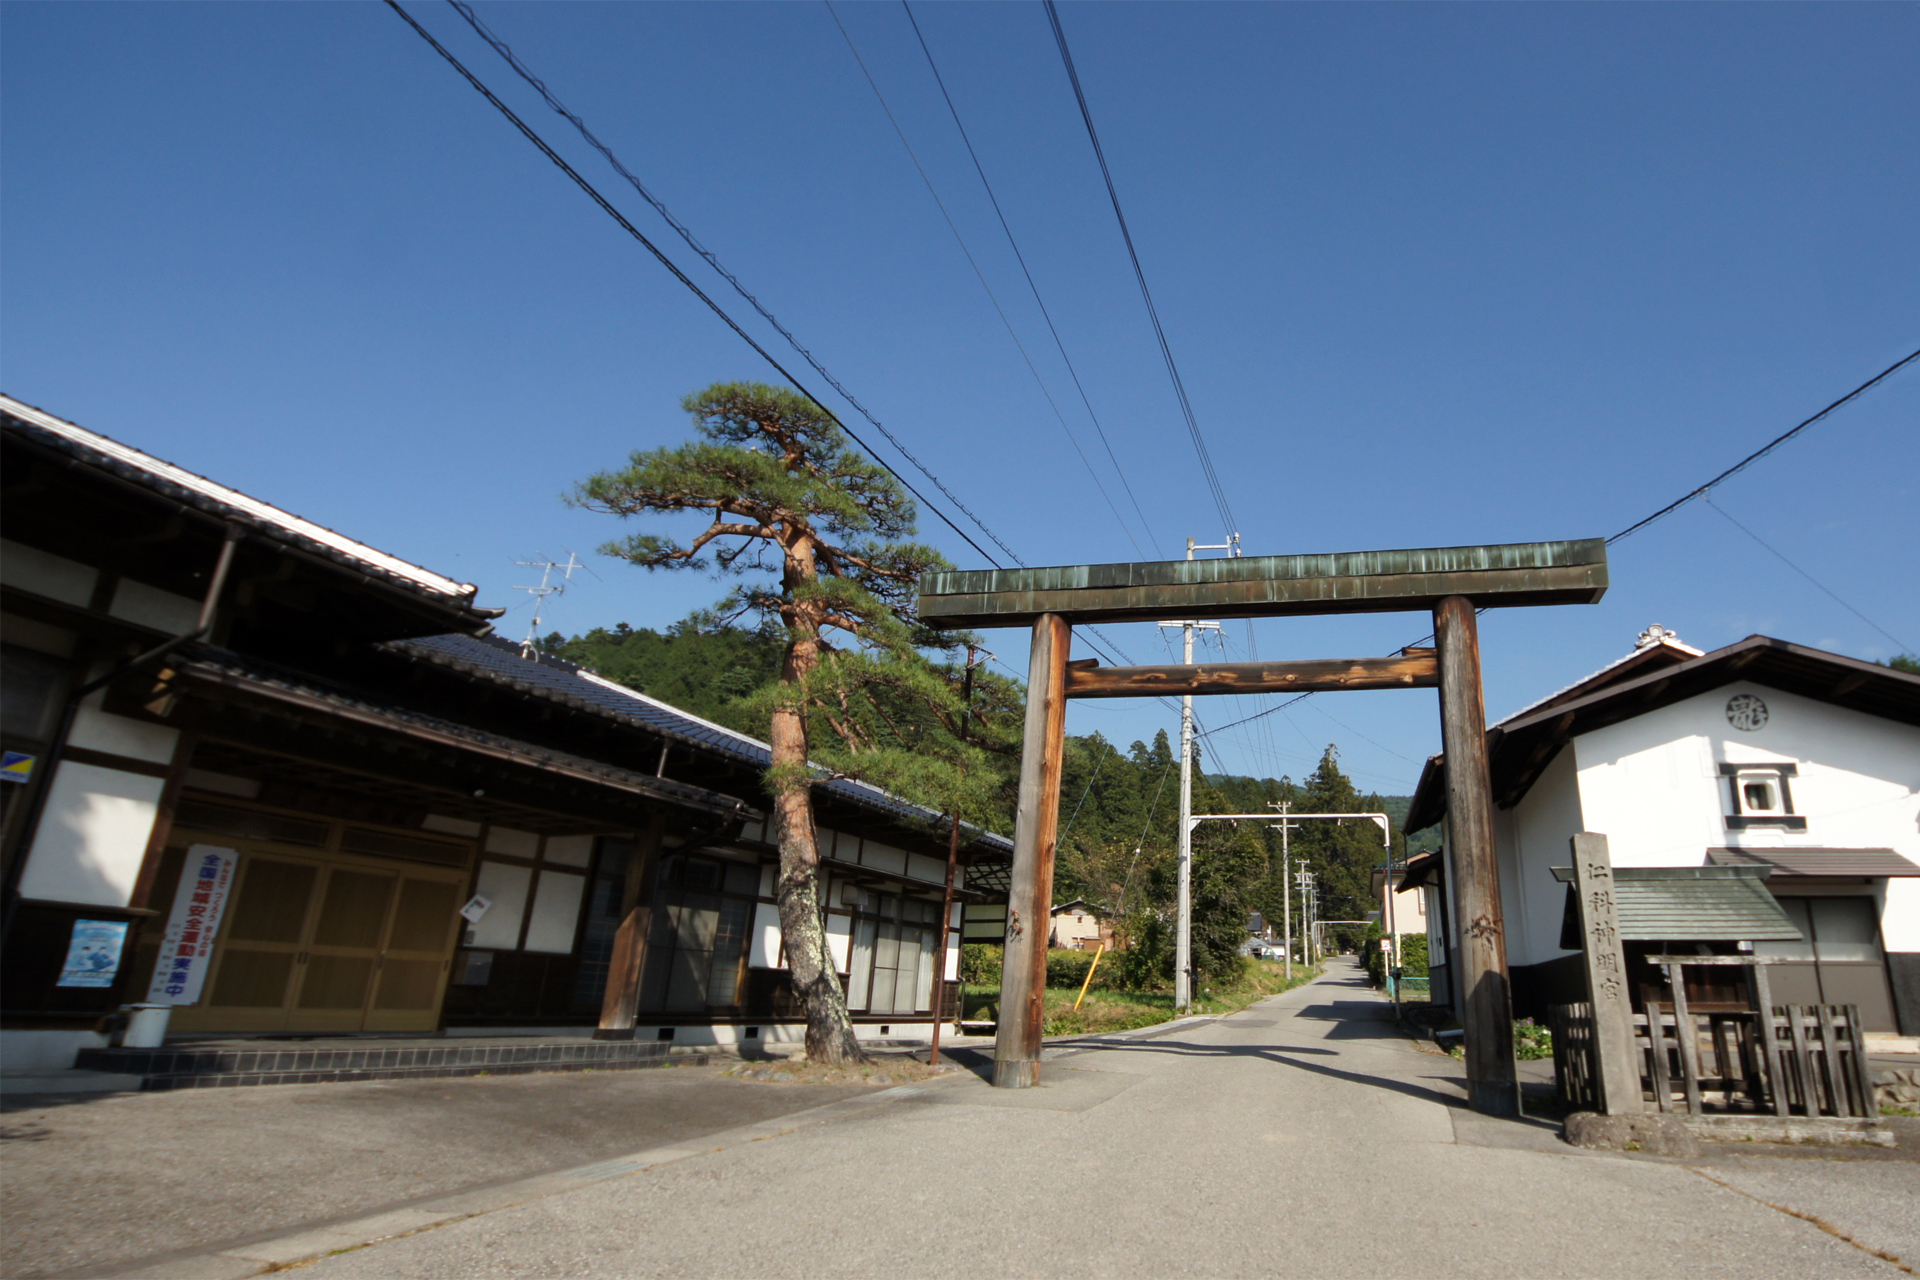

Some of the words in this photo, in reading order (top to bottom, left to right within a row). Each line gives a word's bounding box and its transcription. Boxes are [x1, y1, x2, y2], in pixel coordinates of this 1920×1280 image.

[164, 853, 221, 998] 全国地域安全運動実施中
[1585, 862, 1621, 1001] 仁科神明宮
